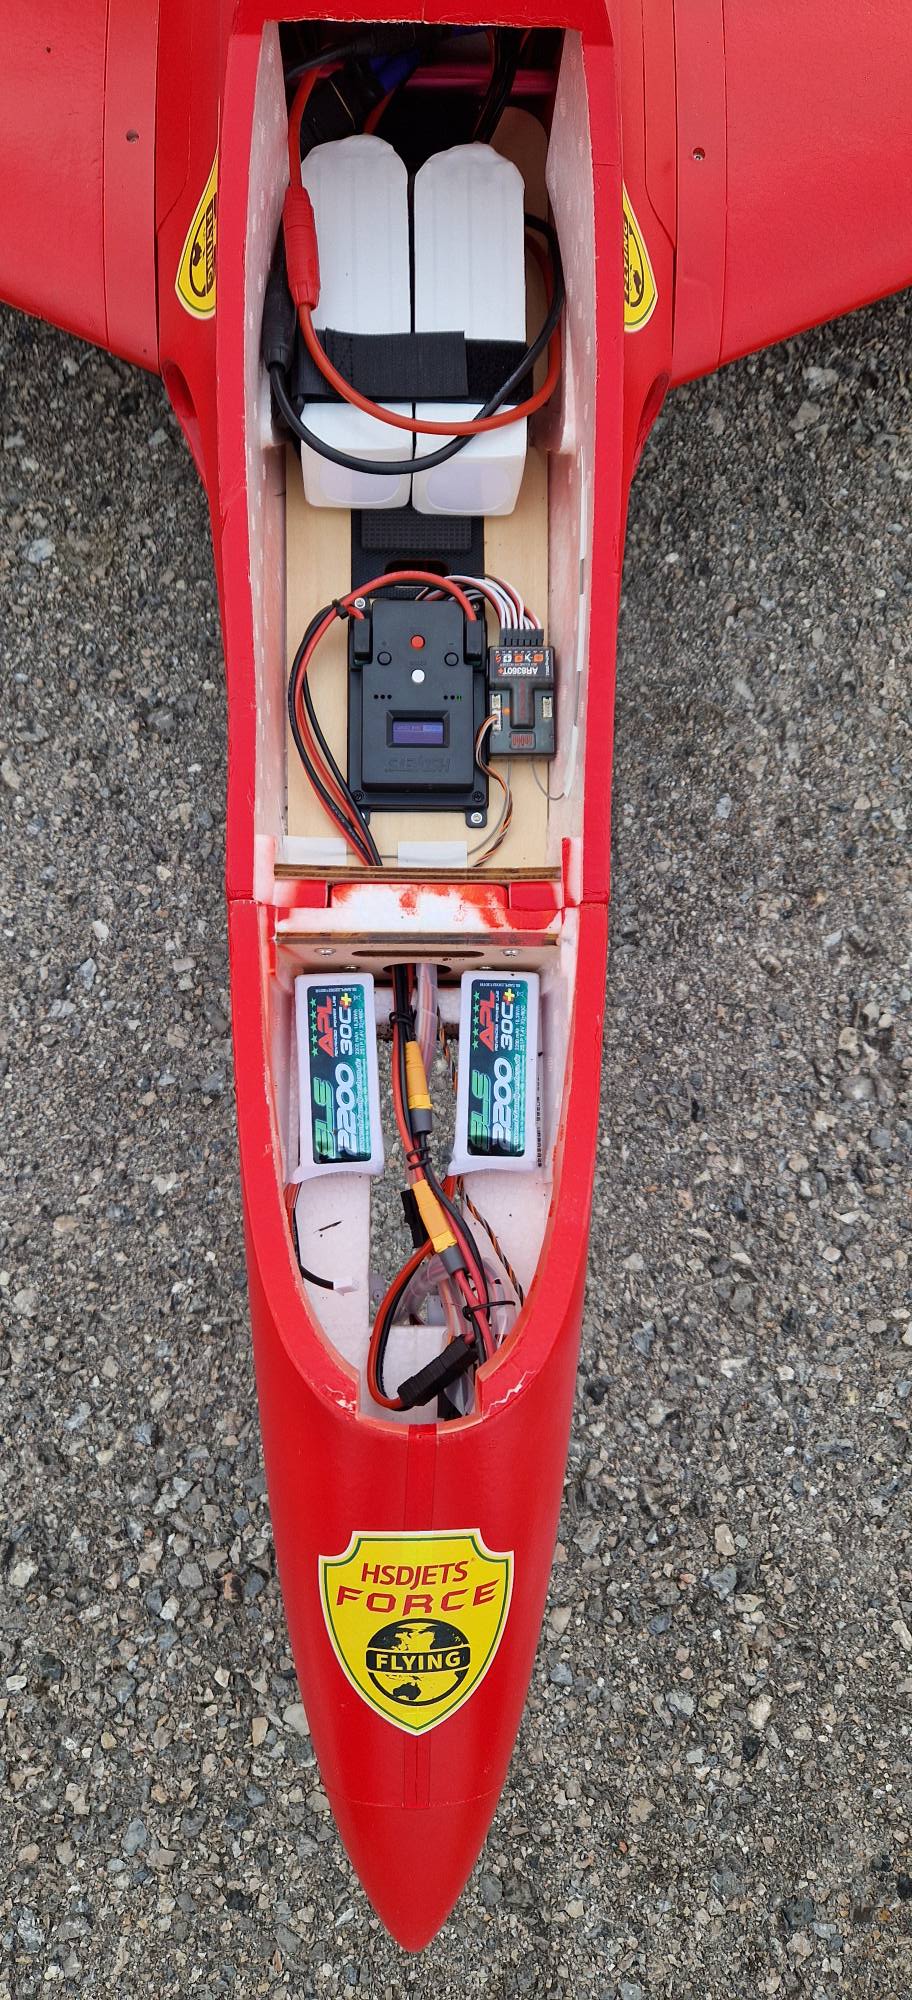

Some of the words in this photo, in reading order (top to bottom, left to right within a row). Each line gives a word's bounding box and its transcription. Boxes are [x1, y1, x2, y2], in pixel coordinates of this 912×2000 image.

[317, 995, 334, 1057] APL
[479, 990, 495, 1052] APL
[335, 1063, 357, 1156] 2200
[491, 1056, 514, 1152] 2200
[336, 1578, 500, 1617] FORCE
[361, 1560, 469, 1590] HSDJETS
[375, 1650, 462, 1671] FLYING
